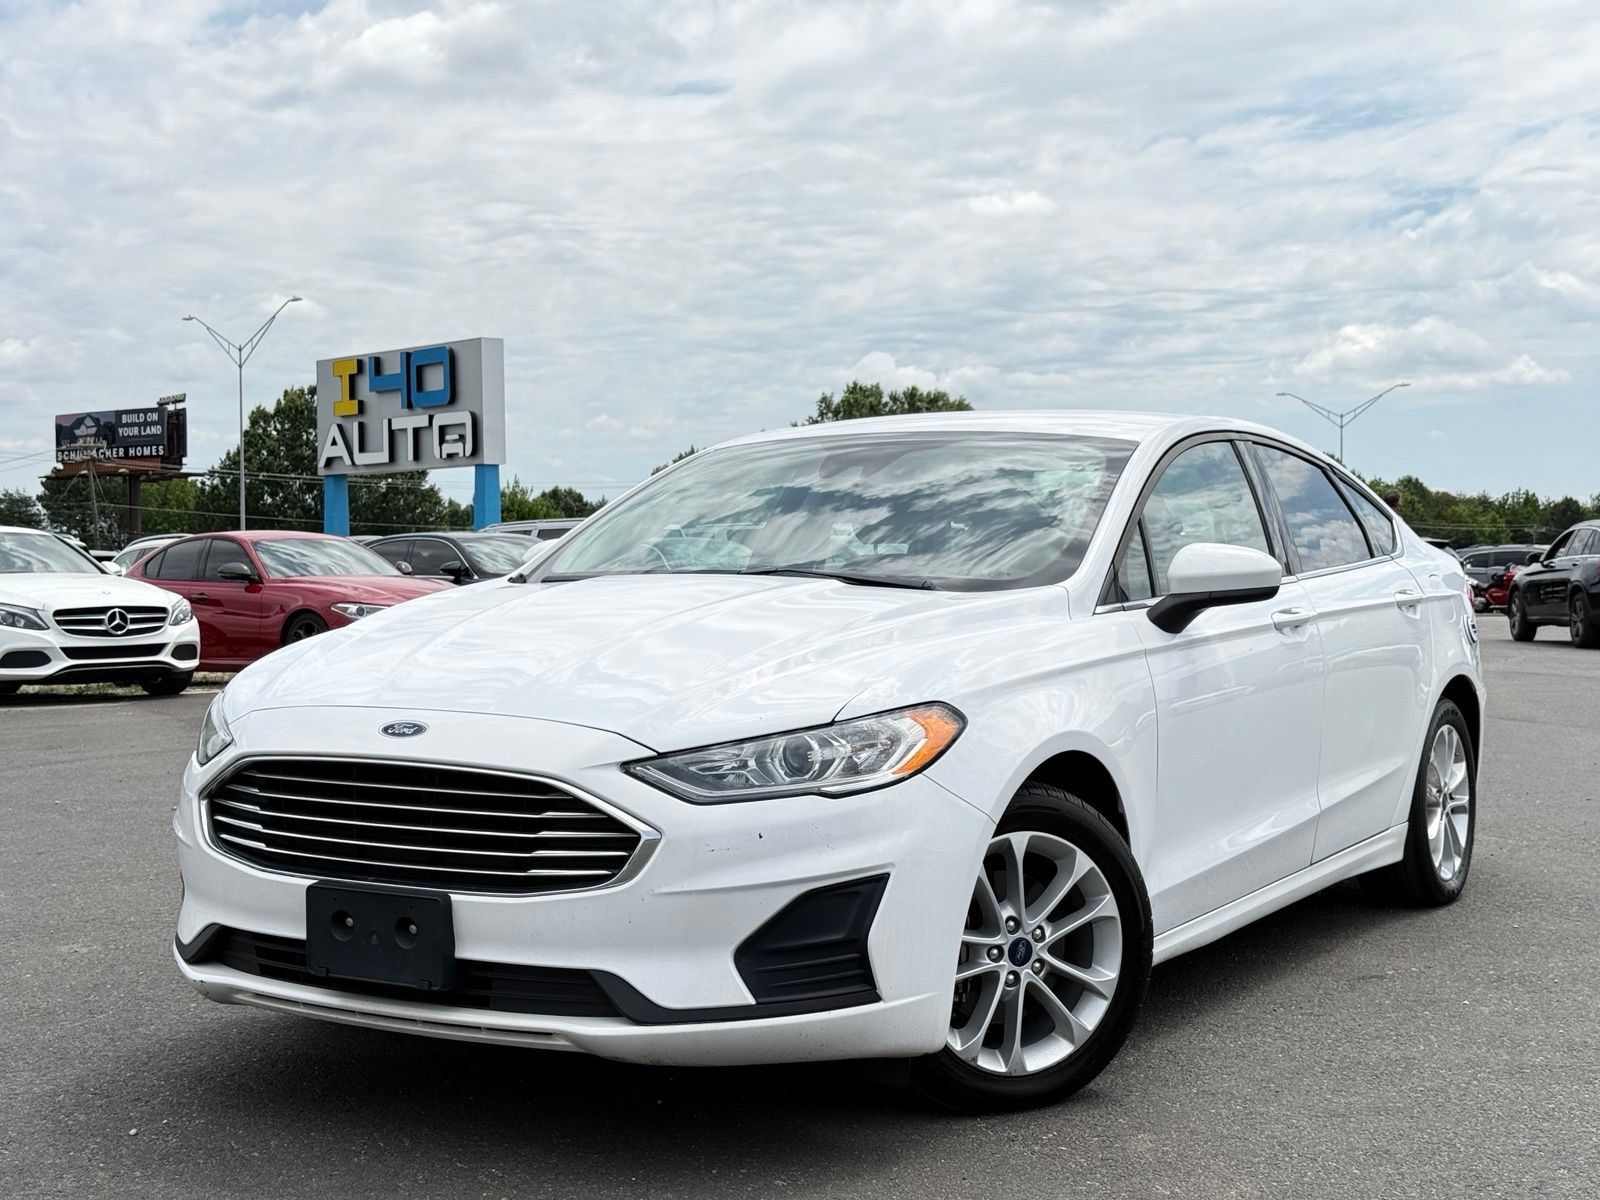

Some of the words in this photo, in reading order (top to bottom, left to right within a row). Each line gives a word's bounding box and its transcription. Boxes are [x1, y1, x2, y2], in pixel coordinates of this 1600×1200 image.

[122, 413, 144, 423] BUILD
[147, 412, 158, 421] ON
[118, 426, 139, 436] YOUR
[141, 425, 162, 435] LAND
[318, 411, 473, 468] AUTO
[57, 447, 125, 461] SCHUACHER
[128, 445, 165, 457] HOMES
